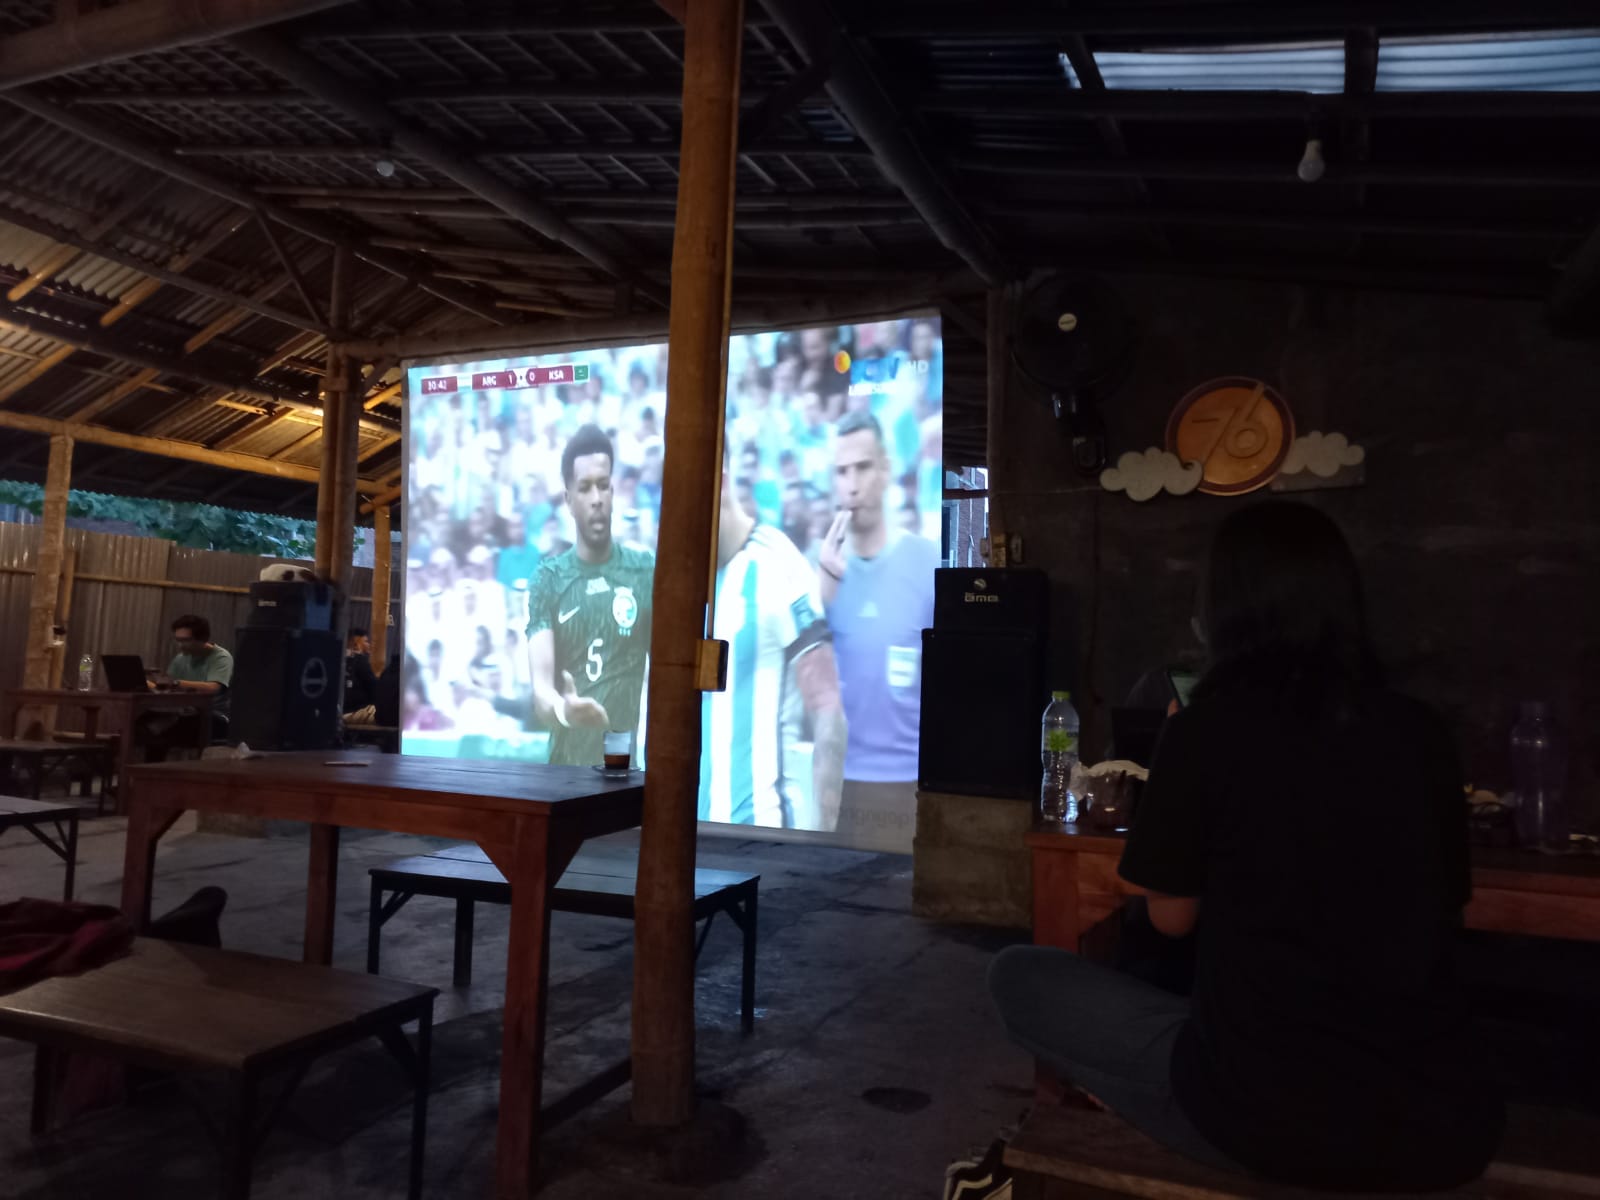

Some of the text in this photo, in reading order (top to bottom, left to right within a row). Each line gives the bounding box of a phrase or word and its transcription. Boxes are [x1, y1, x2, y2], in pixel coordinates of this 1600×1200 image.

[482, 375, 497, 386] ARG
[548, 369, 564, 381] KSA
[585, 638, 603, 682] 5
